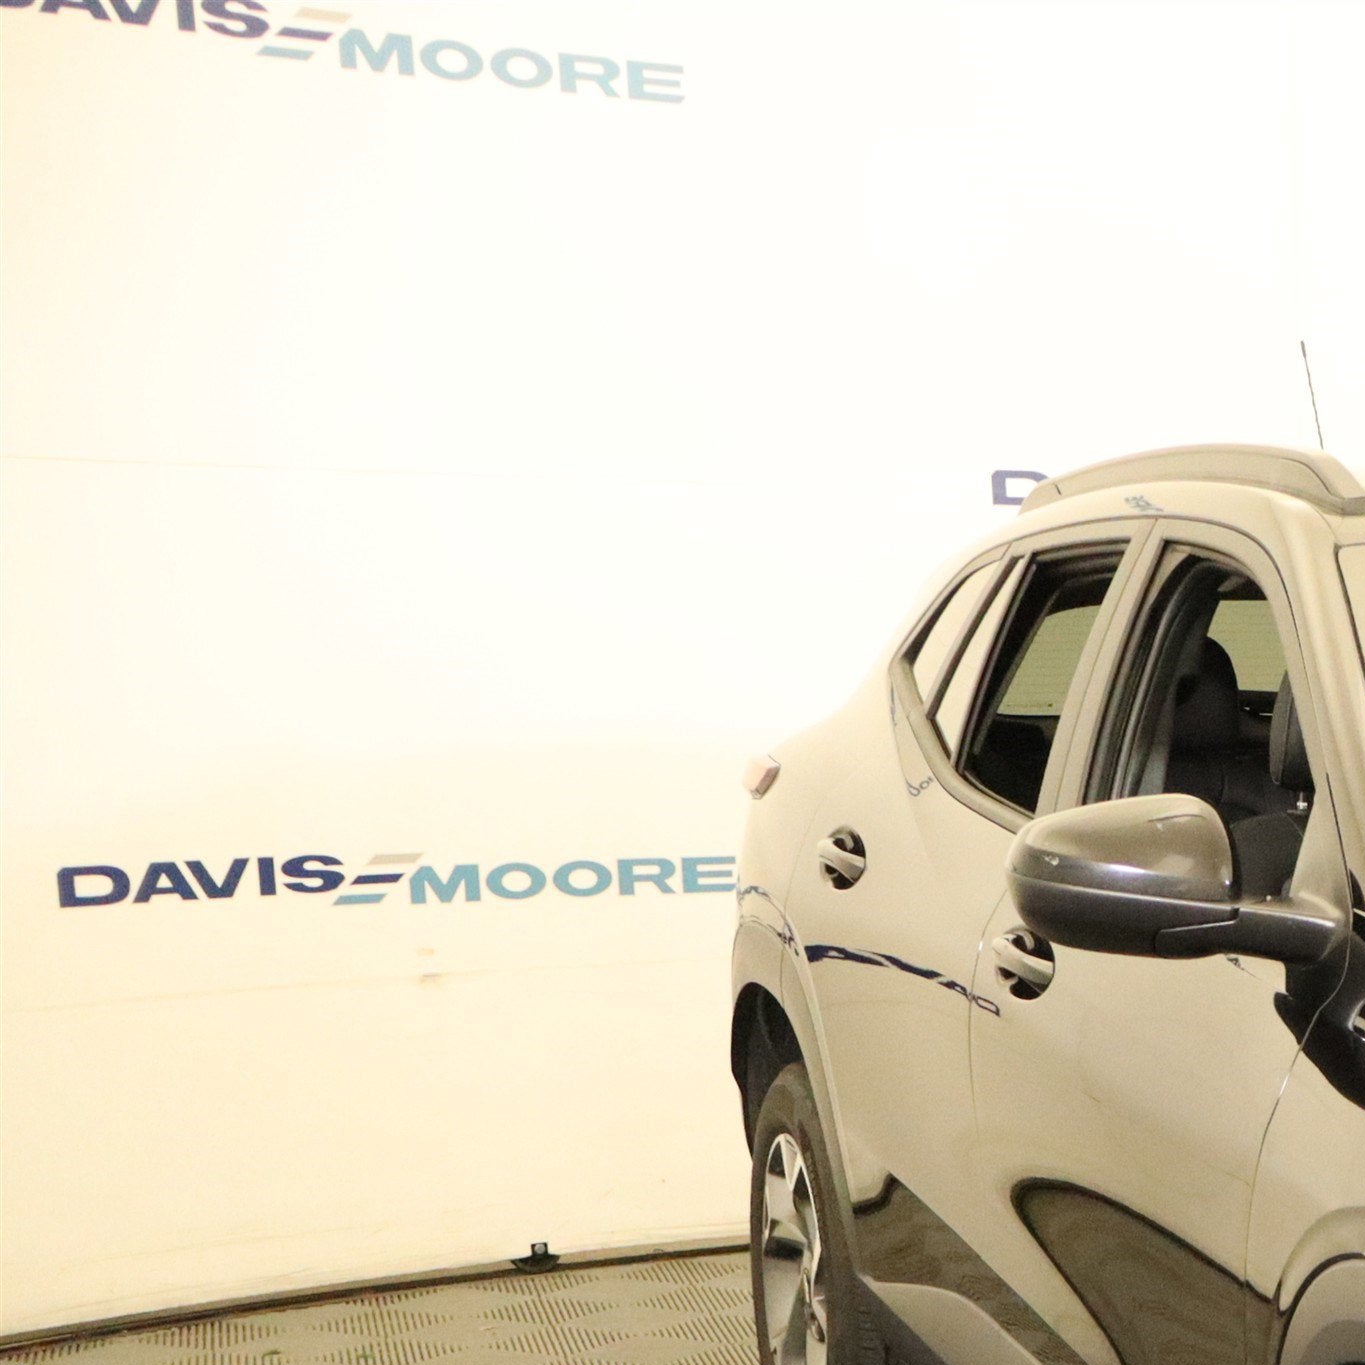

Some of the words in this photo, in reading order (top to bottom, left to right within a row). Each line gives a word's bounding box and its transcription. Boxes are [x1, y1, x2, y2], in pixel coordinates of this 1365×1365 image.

[0, 0, 271, 39] VIS
[337, 28, 687, 104] MOORE
[57, 854, 345, 908] DAVIS
[408, 855, 738, 904] MOORE
